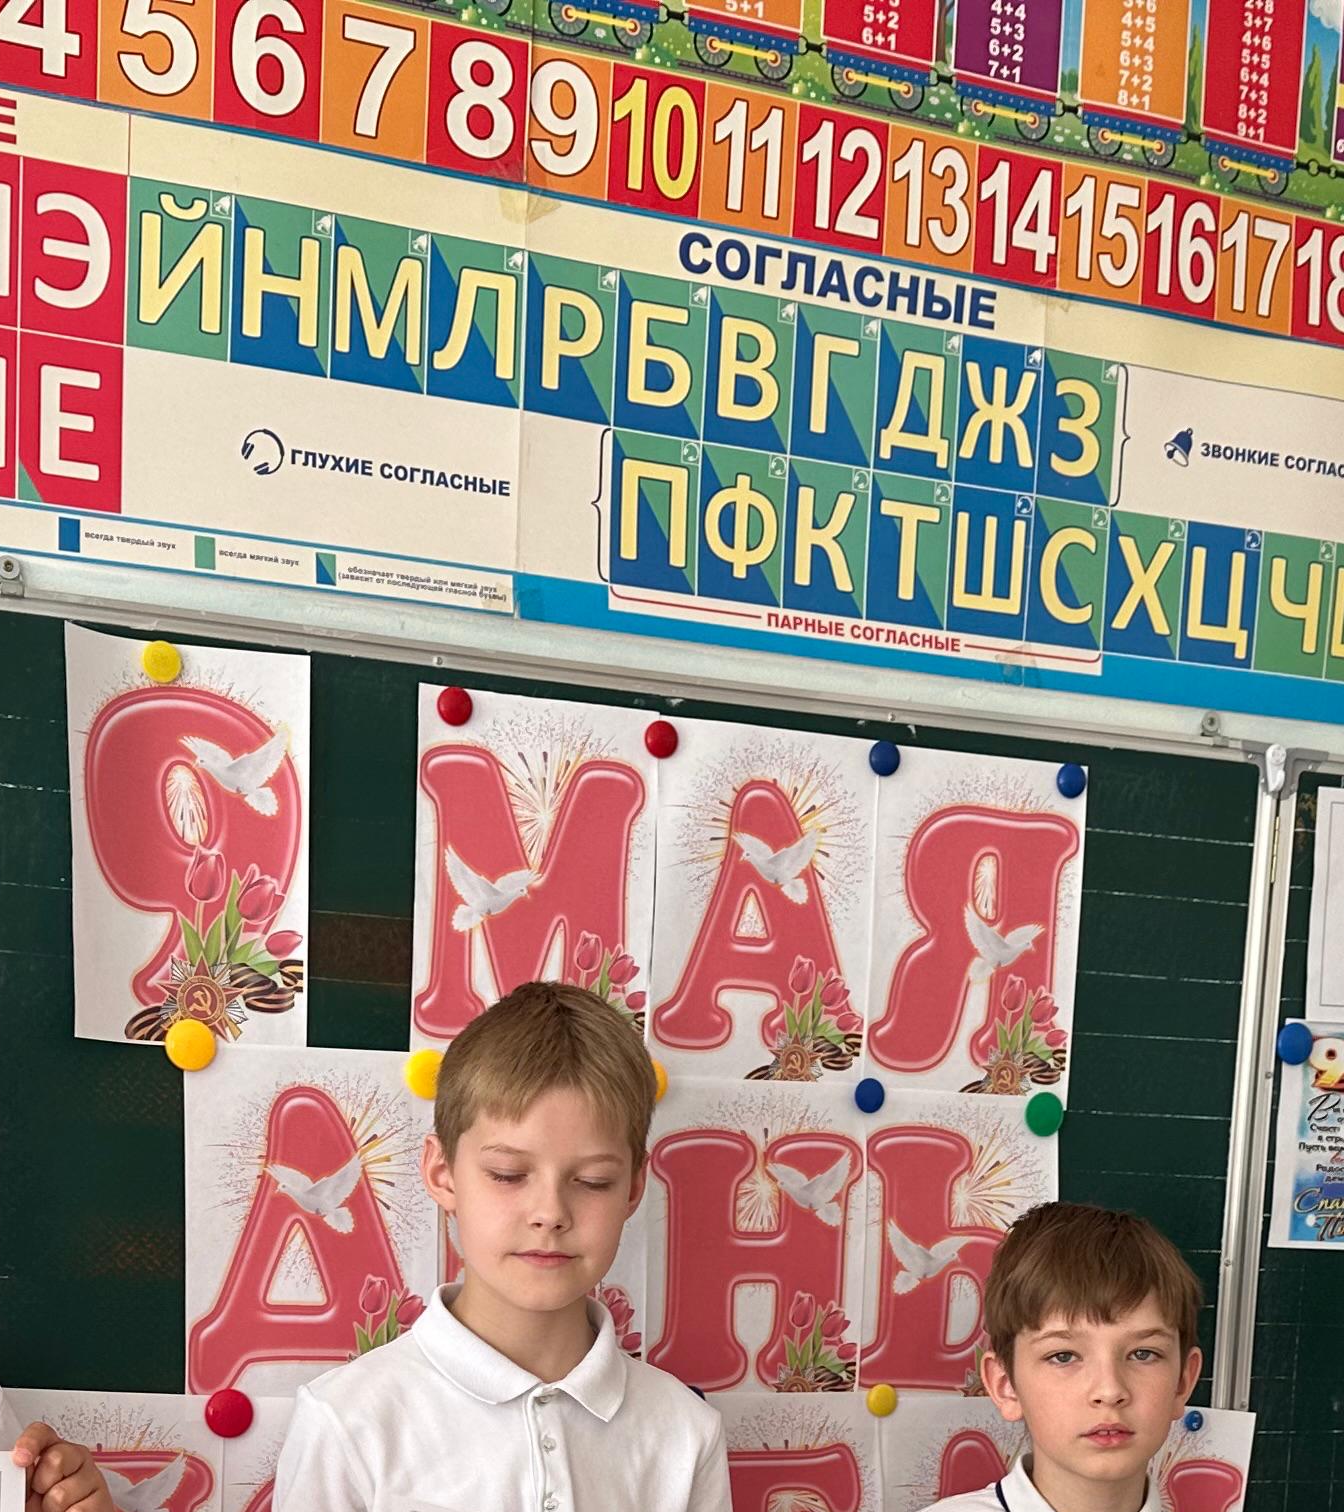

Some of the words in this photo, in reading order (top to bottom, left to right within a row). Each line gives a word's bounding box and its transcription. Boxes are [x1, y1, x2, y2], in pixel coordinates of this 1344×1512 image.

[231, 0, 306, 117] 6
[342, 14, 417, 139] 7
[445, 39, 515, 160] 8
[988, 60, 1021, 83] 7+1
[1117, 89, 1151, 110] 8+1
[528, 58, 600, 177] 9
[612, 77, 703, 200] 10
[714, 97, 784, 220] 11
[1237, 122, 1265, 143] 9+1
[802, 119, 884, 241] 12
[892, 137, 971, 256] 13
[980, 159, 1058, 275] 14
[1064, 174, 1141, 289] 15
[678, 232, 997, 330] СОГЛАСНЫЕ
[1146, 192, 1217, 305] 16
[1221, 209, 1292, 319] 17
[291, 449, 373, 477] ГЛУХИЕ
[380, 462, 511, 497] СОГЛАСНЫЕ
[1201, 442, 1281, 469] ЗВОНКИЕ
[766, 612, 845, 638] ПАРНЫЕ
[850, 624, 961, 654] СОГЛАСНЫЕ
[85, 684, 302, 1012] 9
